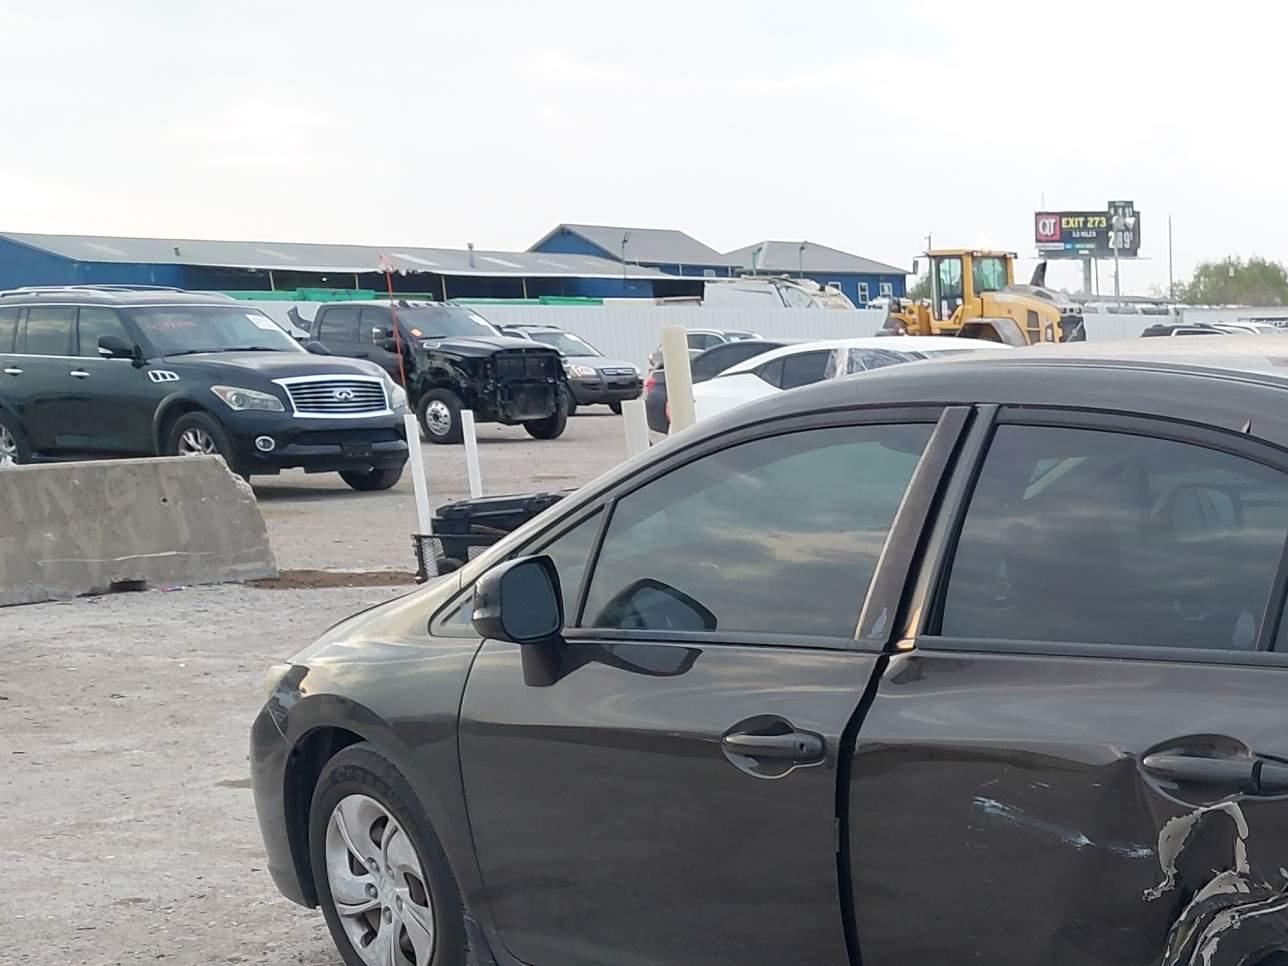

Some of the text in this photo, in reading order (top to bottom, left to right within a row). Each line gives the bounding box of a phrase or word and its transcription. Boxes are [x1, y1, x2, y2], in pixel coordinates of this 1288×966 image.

[1039, 219, 1056, 237] QT
[1061, 216, 1107, 228] EXIT 273
